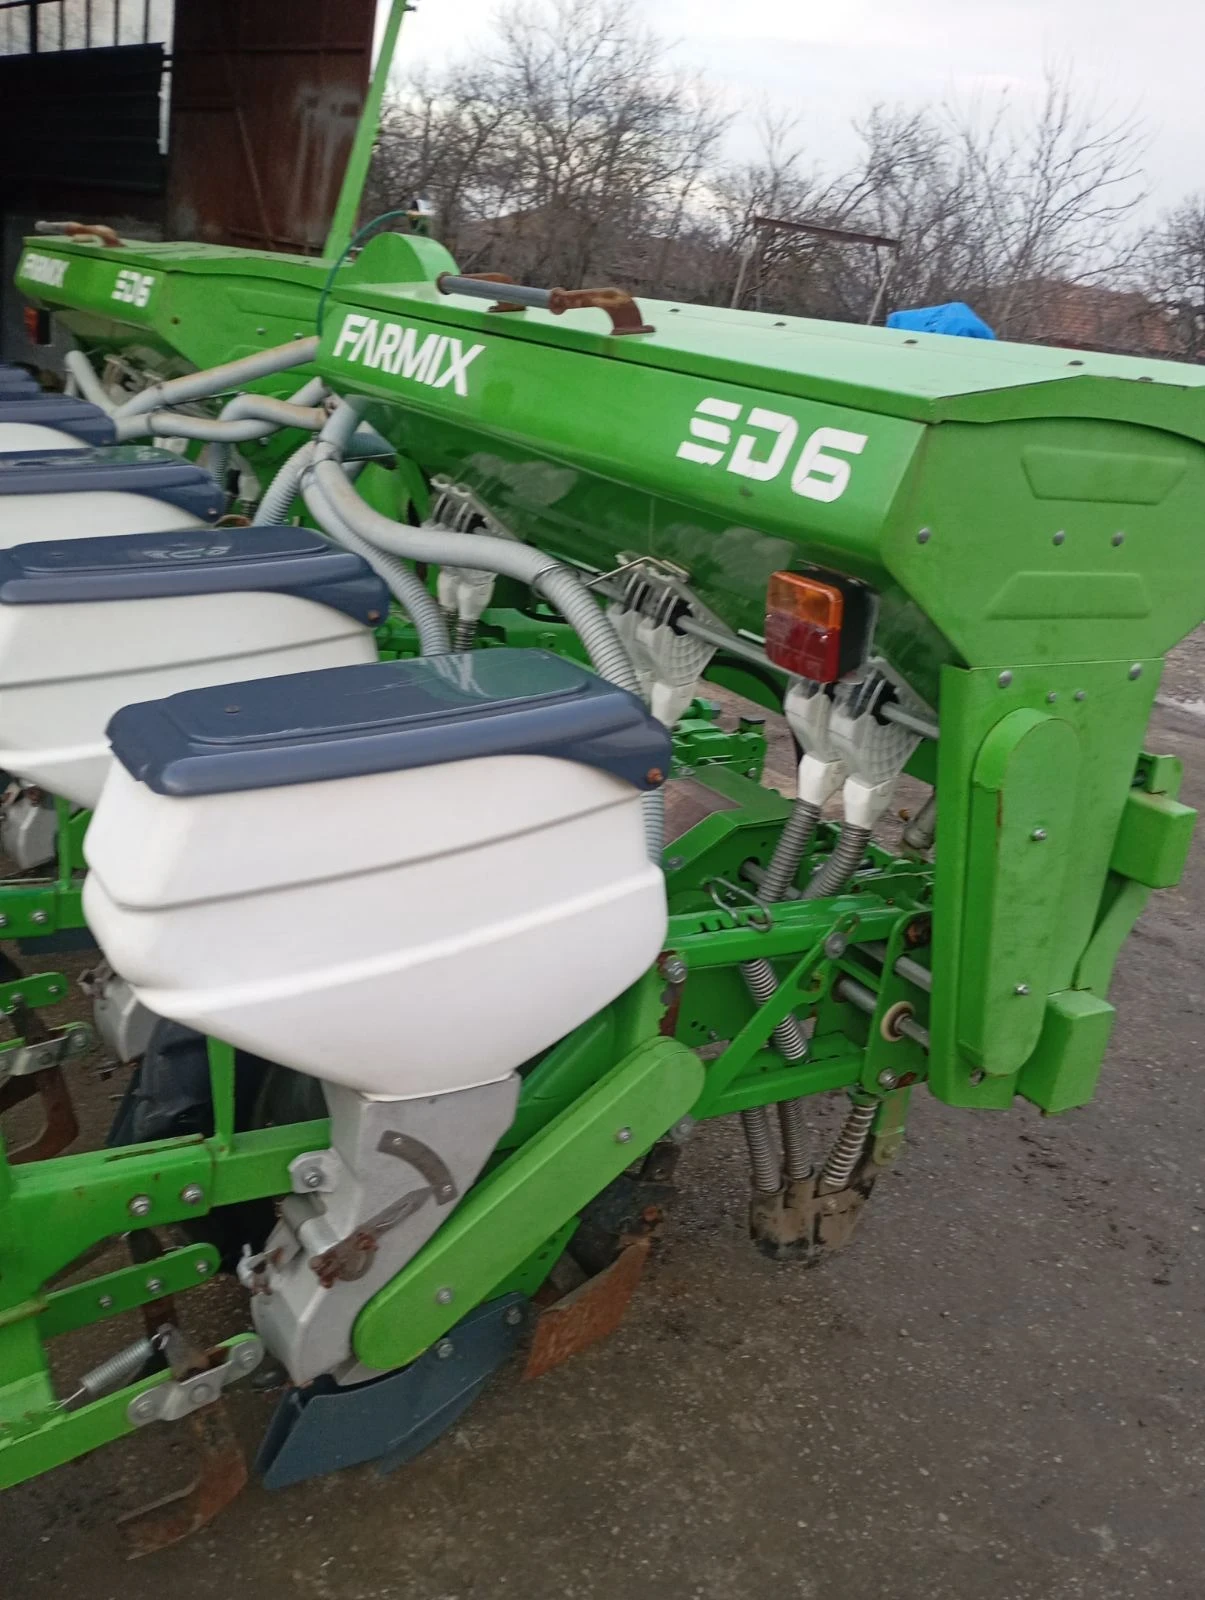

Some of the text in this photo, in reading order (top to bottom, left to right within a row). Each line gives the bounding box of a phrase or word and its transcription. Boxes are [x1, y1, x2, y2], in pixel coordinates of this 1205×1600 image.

[111, 270, 155, 307] SD6
[332, 314, 487, 397] FARMIX
[676, 397, 868, 503] SD6
